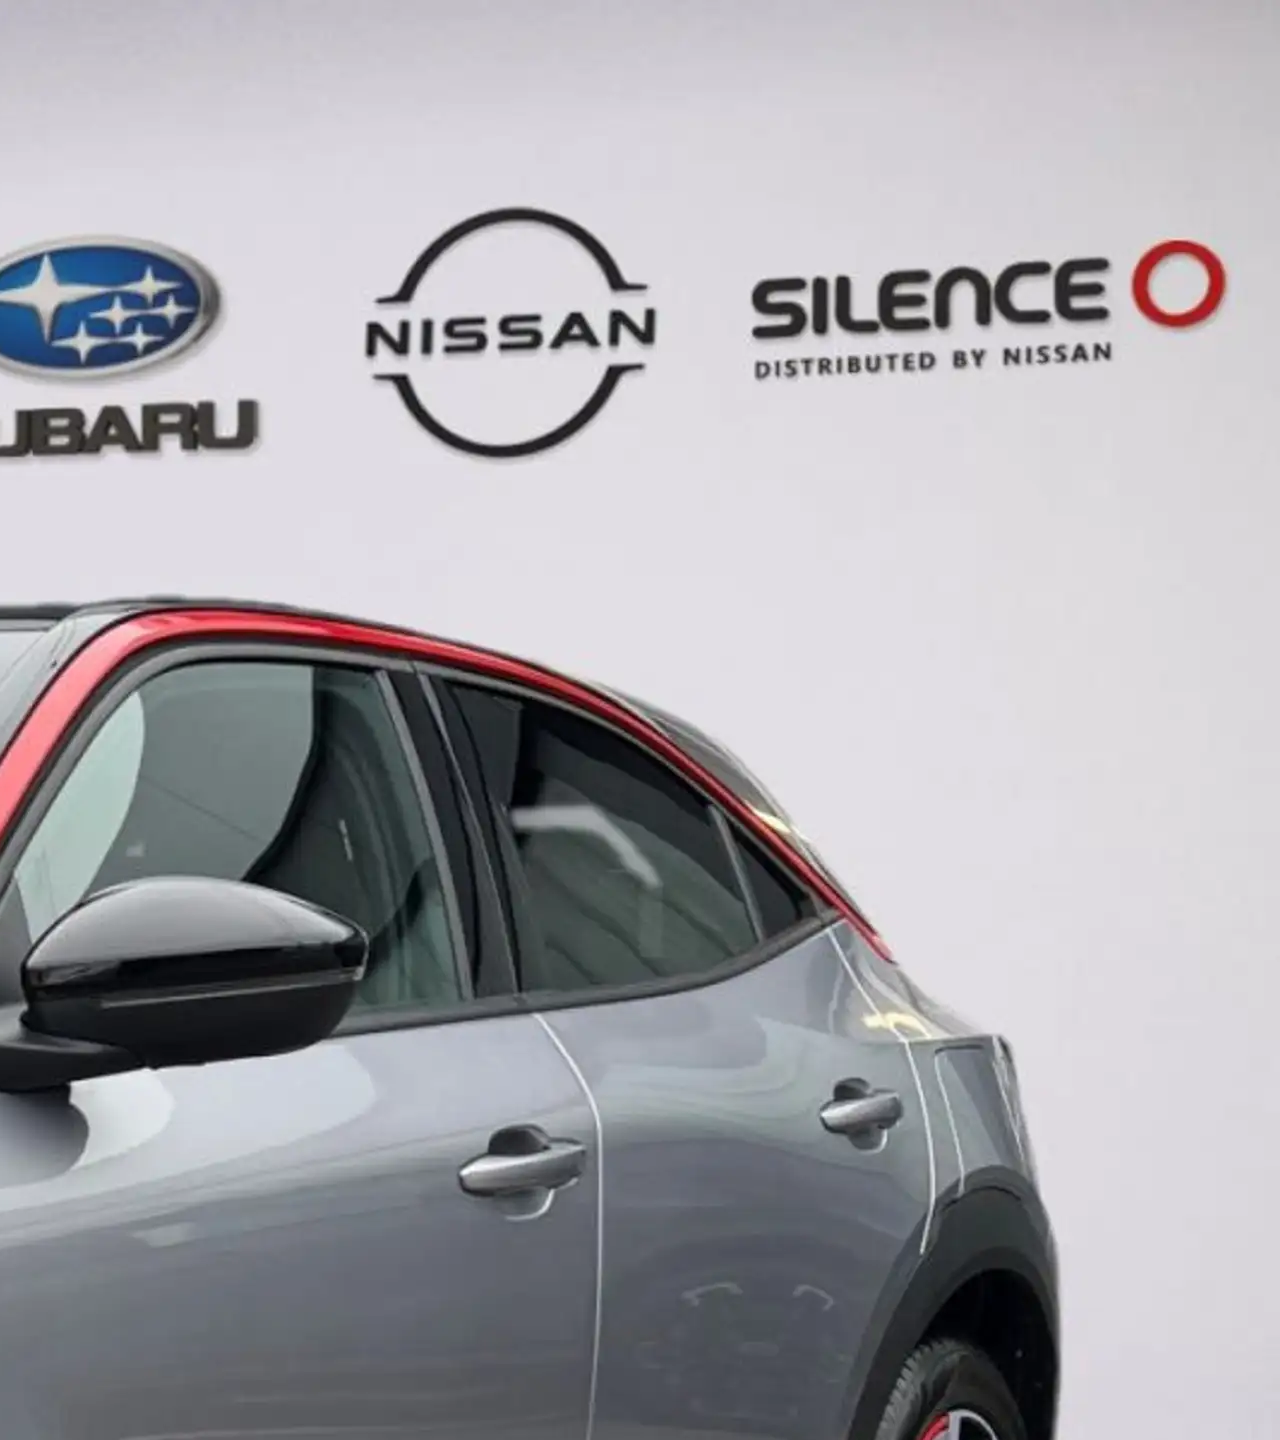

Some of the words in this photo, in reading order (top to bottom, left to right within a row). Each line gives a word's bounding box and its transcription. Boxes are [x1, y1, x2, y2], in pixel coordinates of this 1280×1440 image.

[751, 257, 1110, 339] SILENCE
[366, 307, 657, 359] NISSAN
[754, 351, 937, 380] DISTRIBUTED
[952, 348, 987, 369] BY
[1002, 342, 1112, 366] NISSAN
